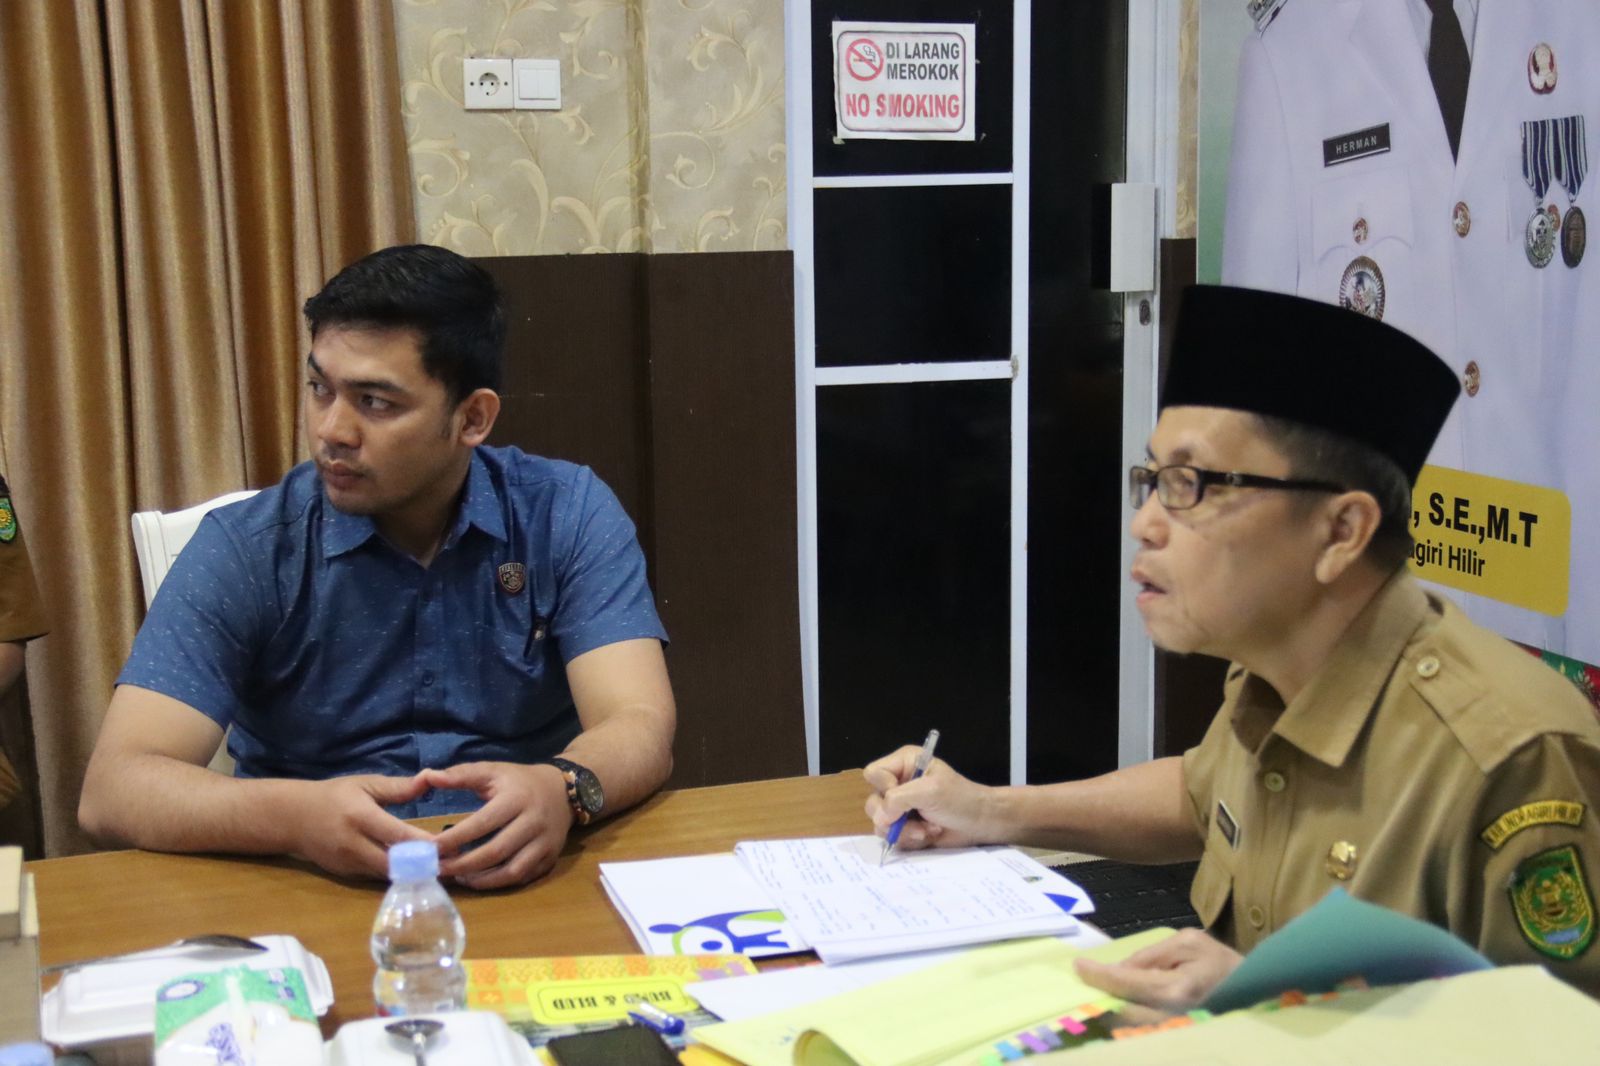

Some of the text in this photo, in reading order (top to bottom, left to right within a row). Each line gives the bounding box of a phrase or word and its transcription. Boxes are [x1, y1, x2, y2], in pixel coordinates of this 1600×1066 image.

[886, 42, 960, 60] DI LARANG
[886, 63, 960, 80] MEROKOK
[846, 93, 960, 118] NO SMOKING
[1335, 135, 1377, 154] HERMAN
[1448, 545, 1486, 577] Hilir
